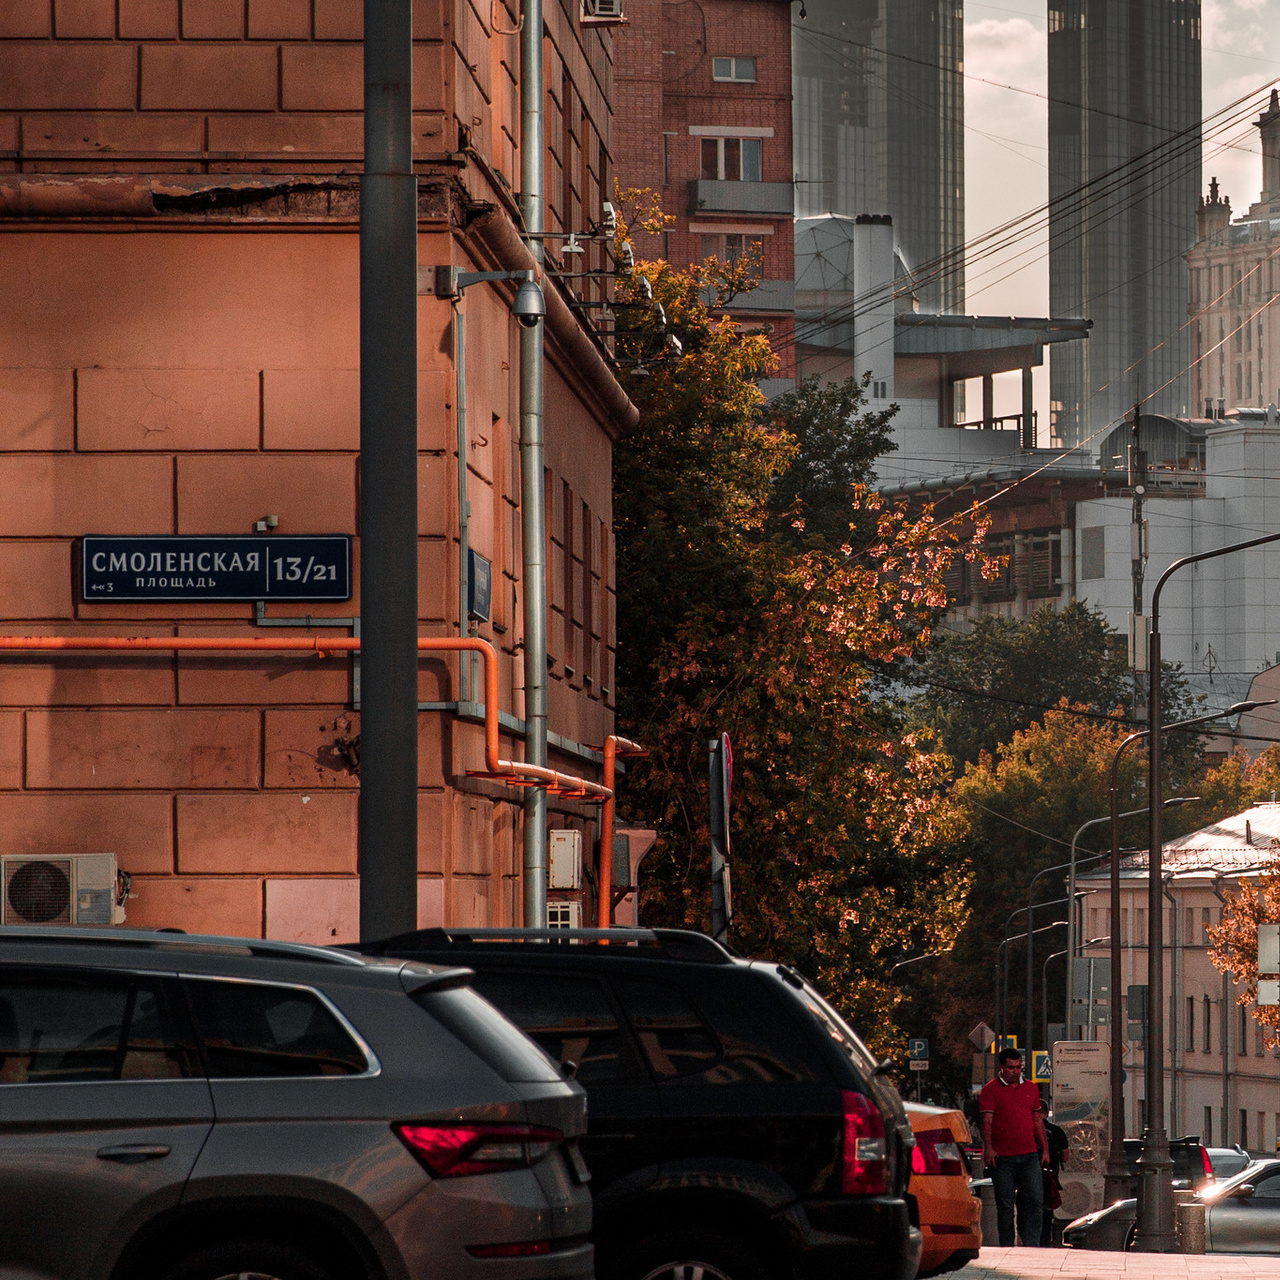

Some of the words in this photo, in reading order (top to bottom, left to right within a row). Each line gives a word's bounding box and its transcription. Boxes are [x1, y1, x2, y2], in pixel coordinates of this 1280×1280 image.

[92, 552, 260, 572] СМОЛЕНСКАЯ
[273, 556, 337, 584] 13/21
[107, 583, 114, 592] 3
[135, 577, 217, 589] ПЛОЩАДЬ
